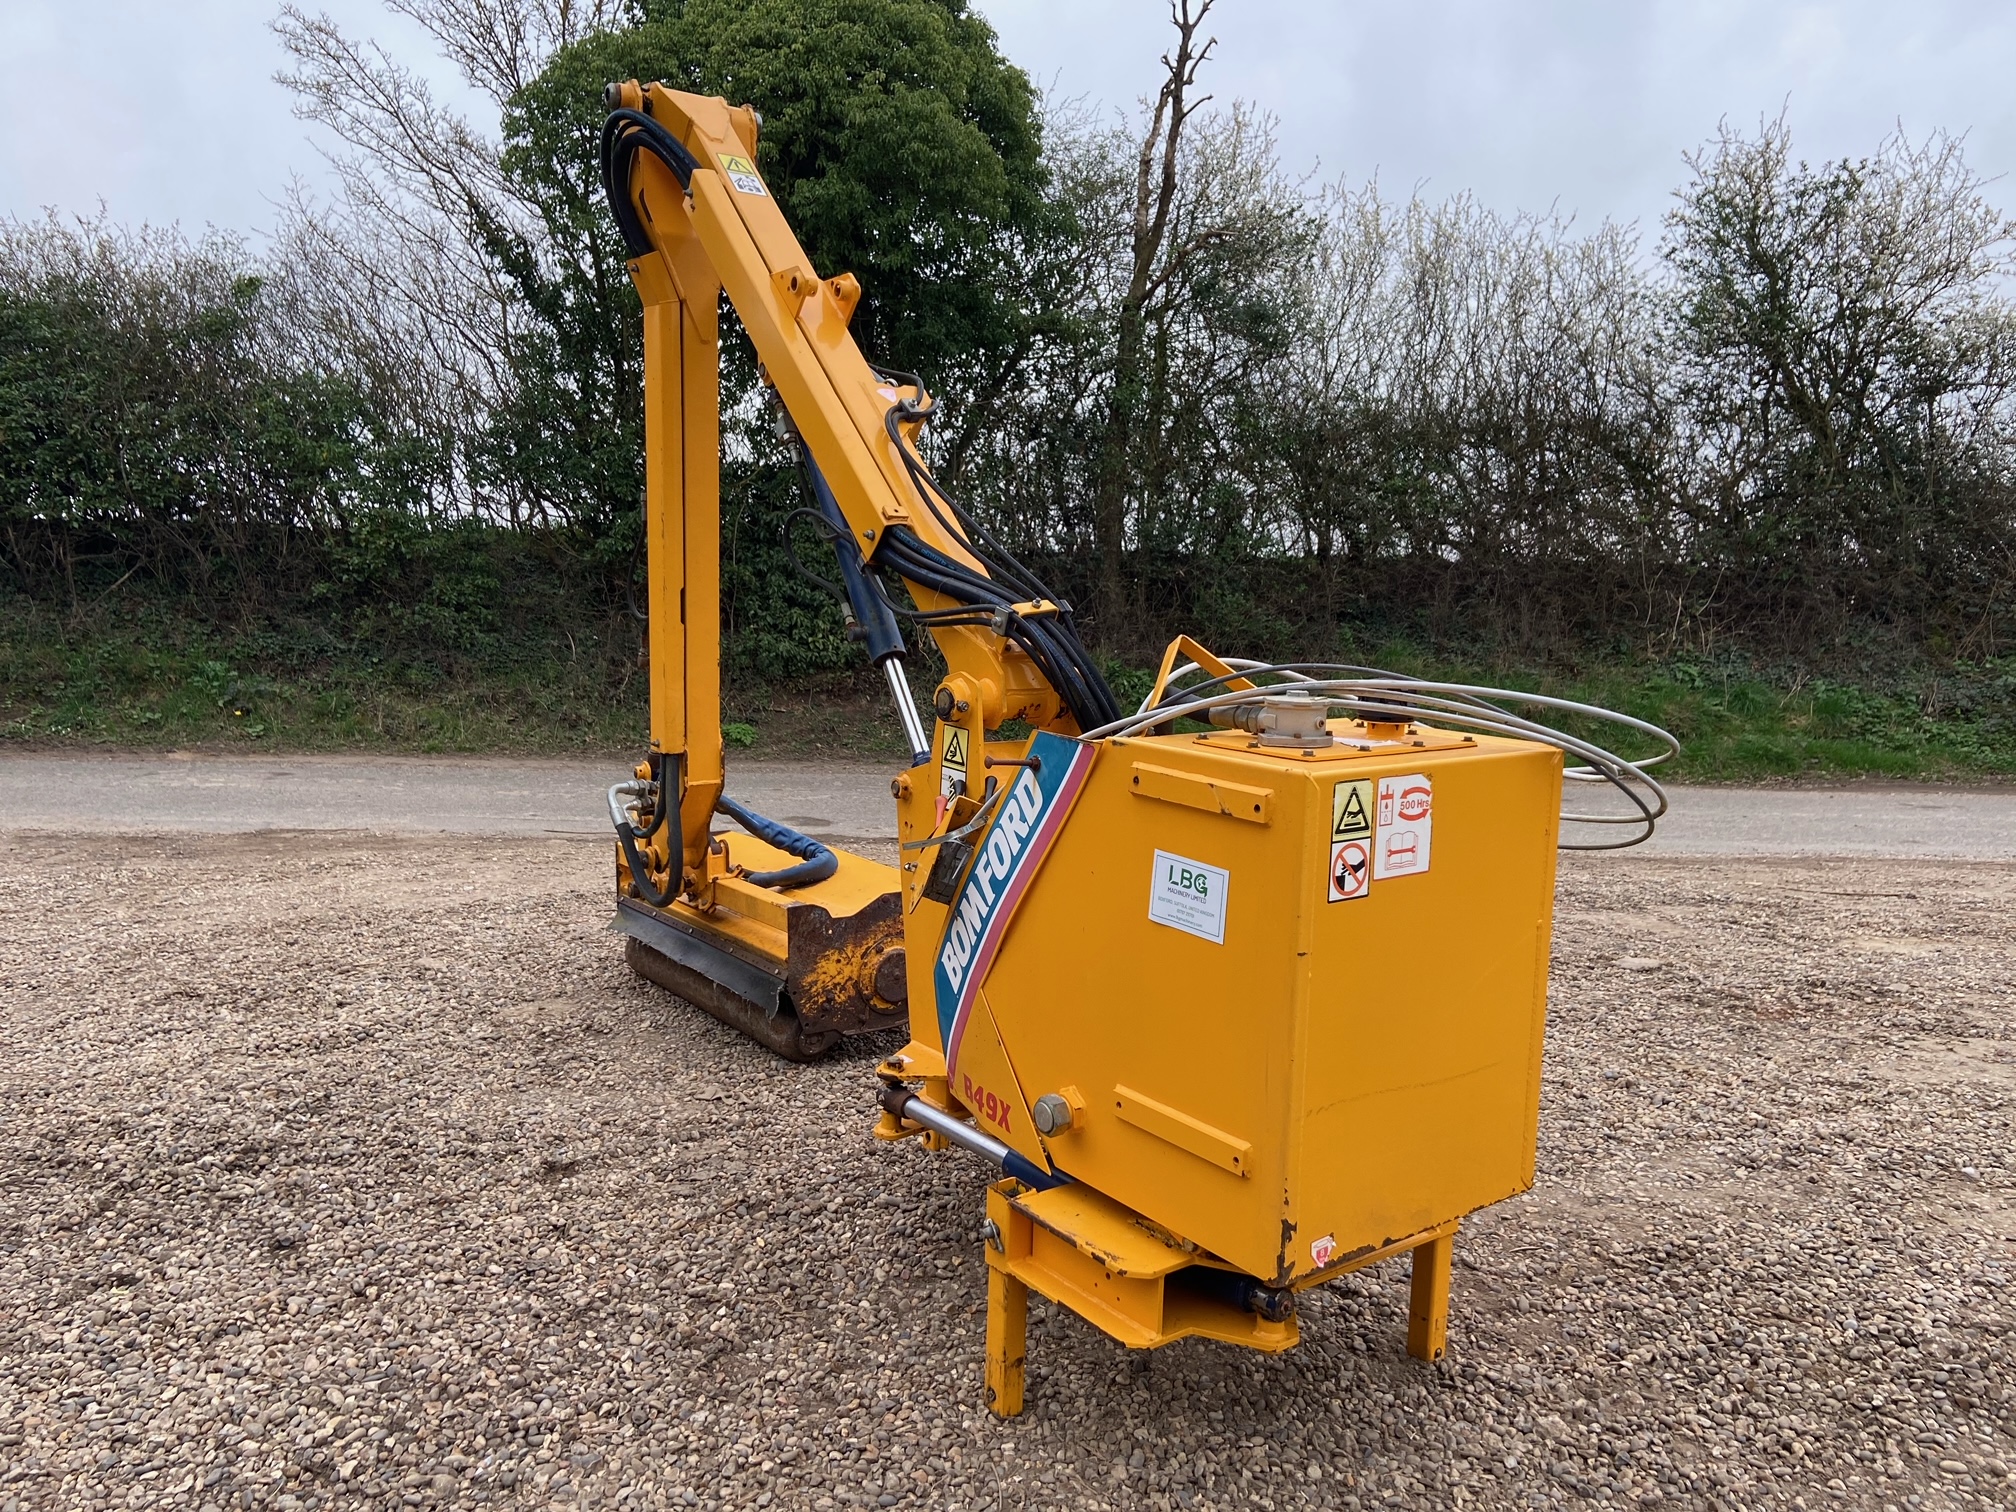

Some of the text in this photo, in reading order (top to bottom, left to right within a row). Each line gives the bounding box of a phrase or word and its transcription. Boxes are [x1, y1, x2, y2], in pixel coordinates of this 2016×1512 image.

[1400, 799, 1430, 811] 500 Hrs
[941, 768, 1043, 995] BOMFORD
[1168, 865, 1208, 898] LBG
[1167, 887, 1207, 905] MACHINERY LIMITED
